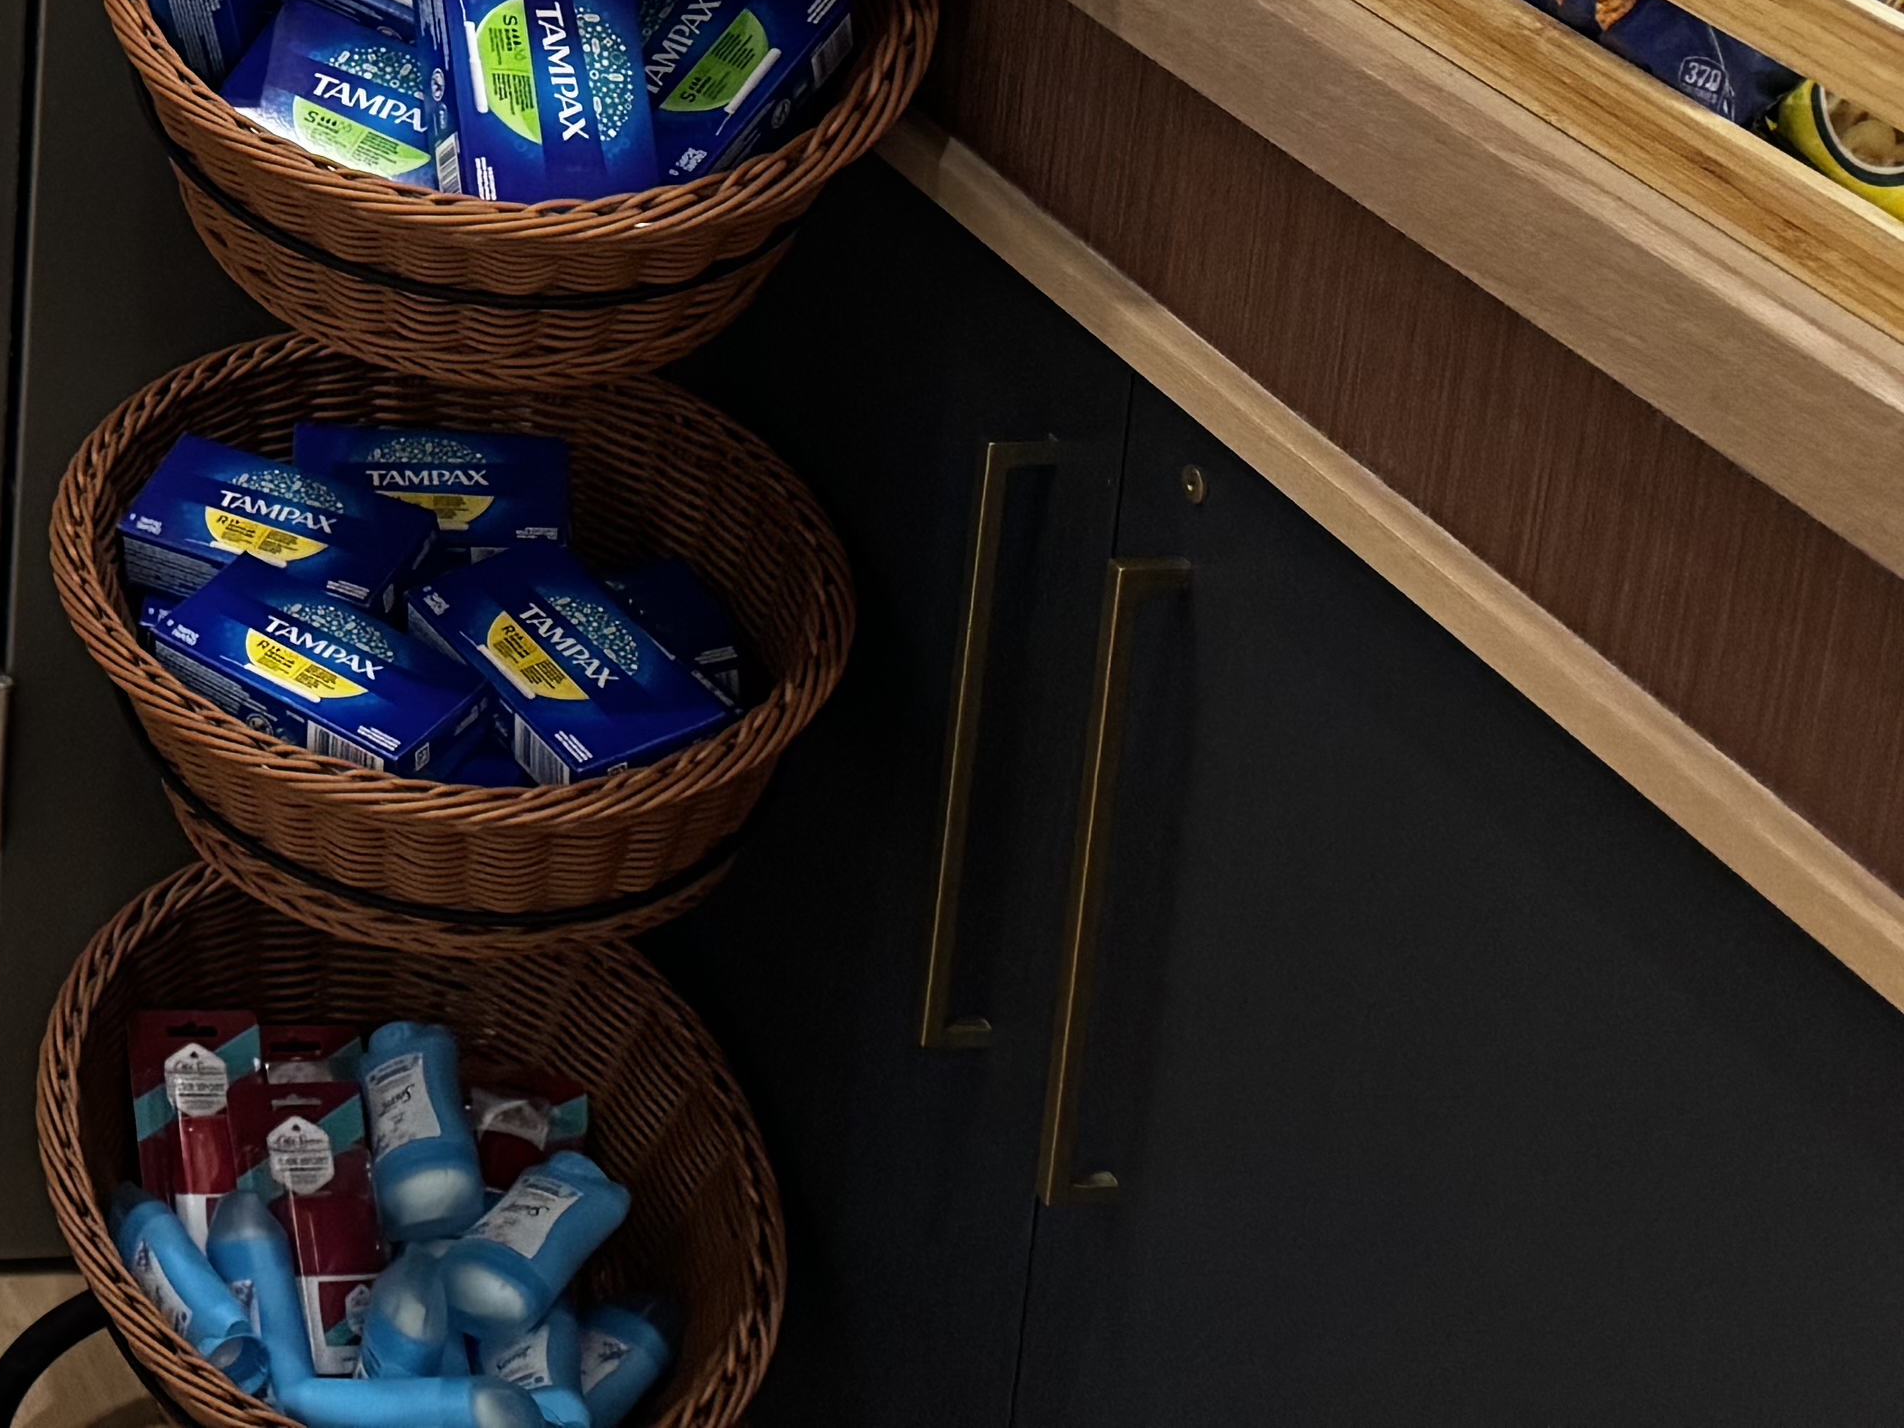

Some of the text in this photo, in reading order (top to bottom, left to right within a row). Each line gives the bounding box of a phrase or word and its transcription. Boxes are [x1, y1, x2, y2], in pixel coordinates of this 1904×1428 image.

[534, 1, 588, 142] TAMPAX
[219, 490, 337, 535] TAMPAX
[265, 615, 383, 680] TAMPAX
[517, 603, 619, 690] TAMPAX
